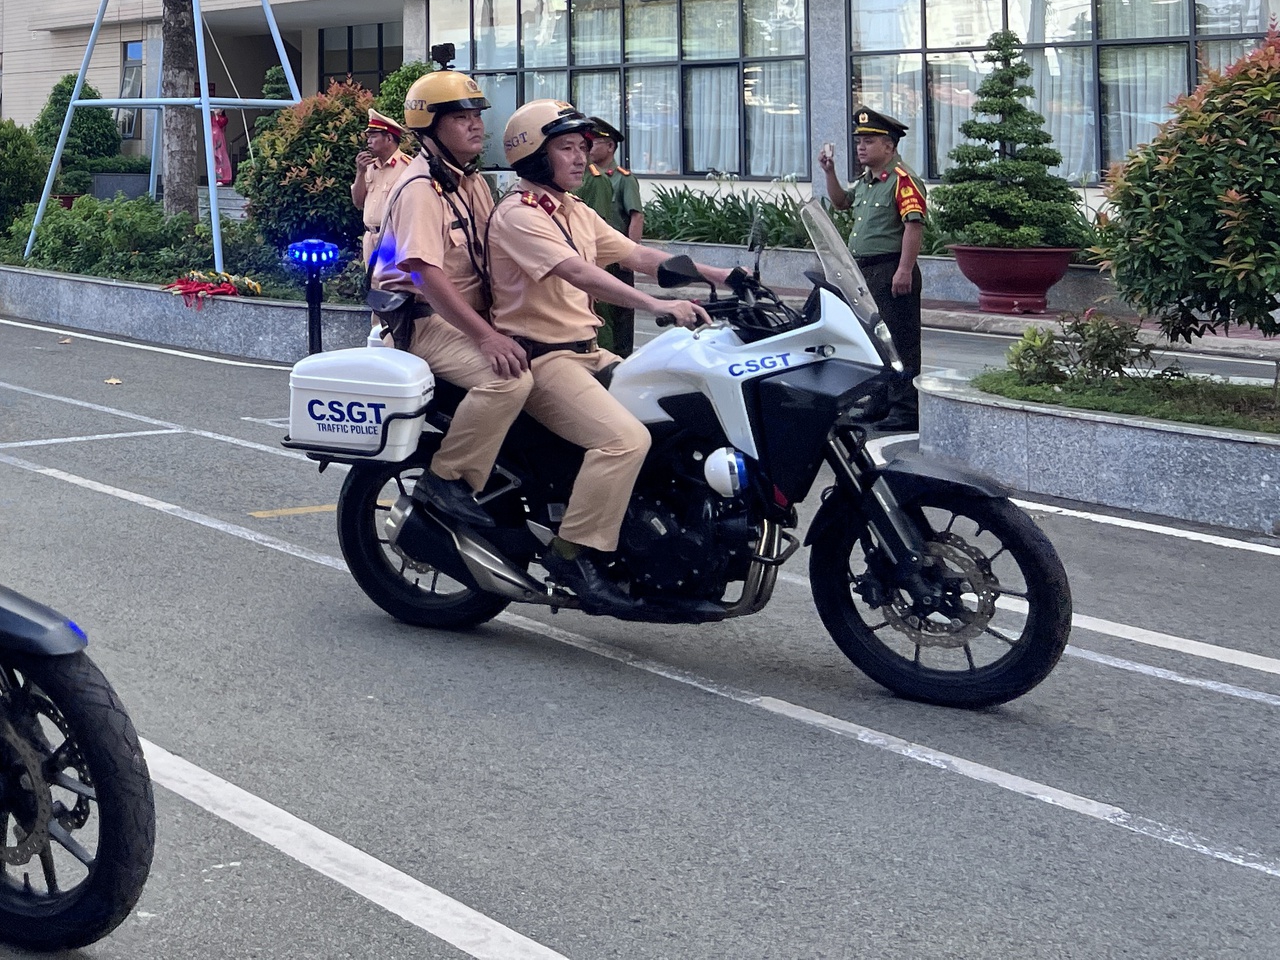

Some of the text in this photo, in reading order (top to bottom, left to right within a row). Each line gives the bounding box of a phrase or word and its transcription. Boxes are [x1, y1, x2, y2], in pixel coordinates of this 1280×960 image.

[307, 399, 386, 425] C.S.G.T
[316, 422, 379, 436] TRAFFIC POLICE
